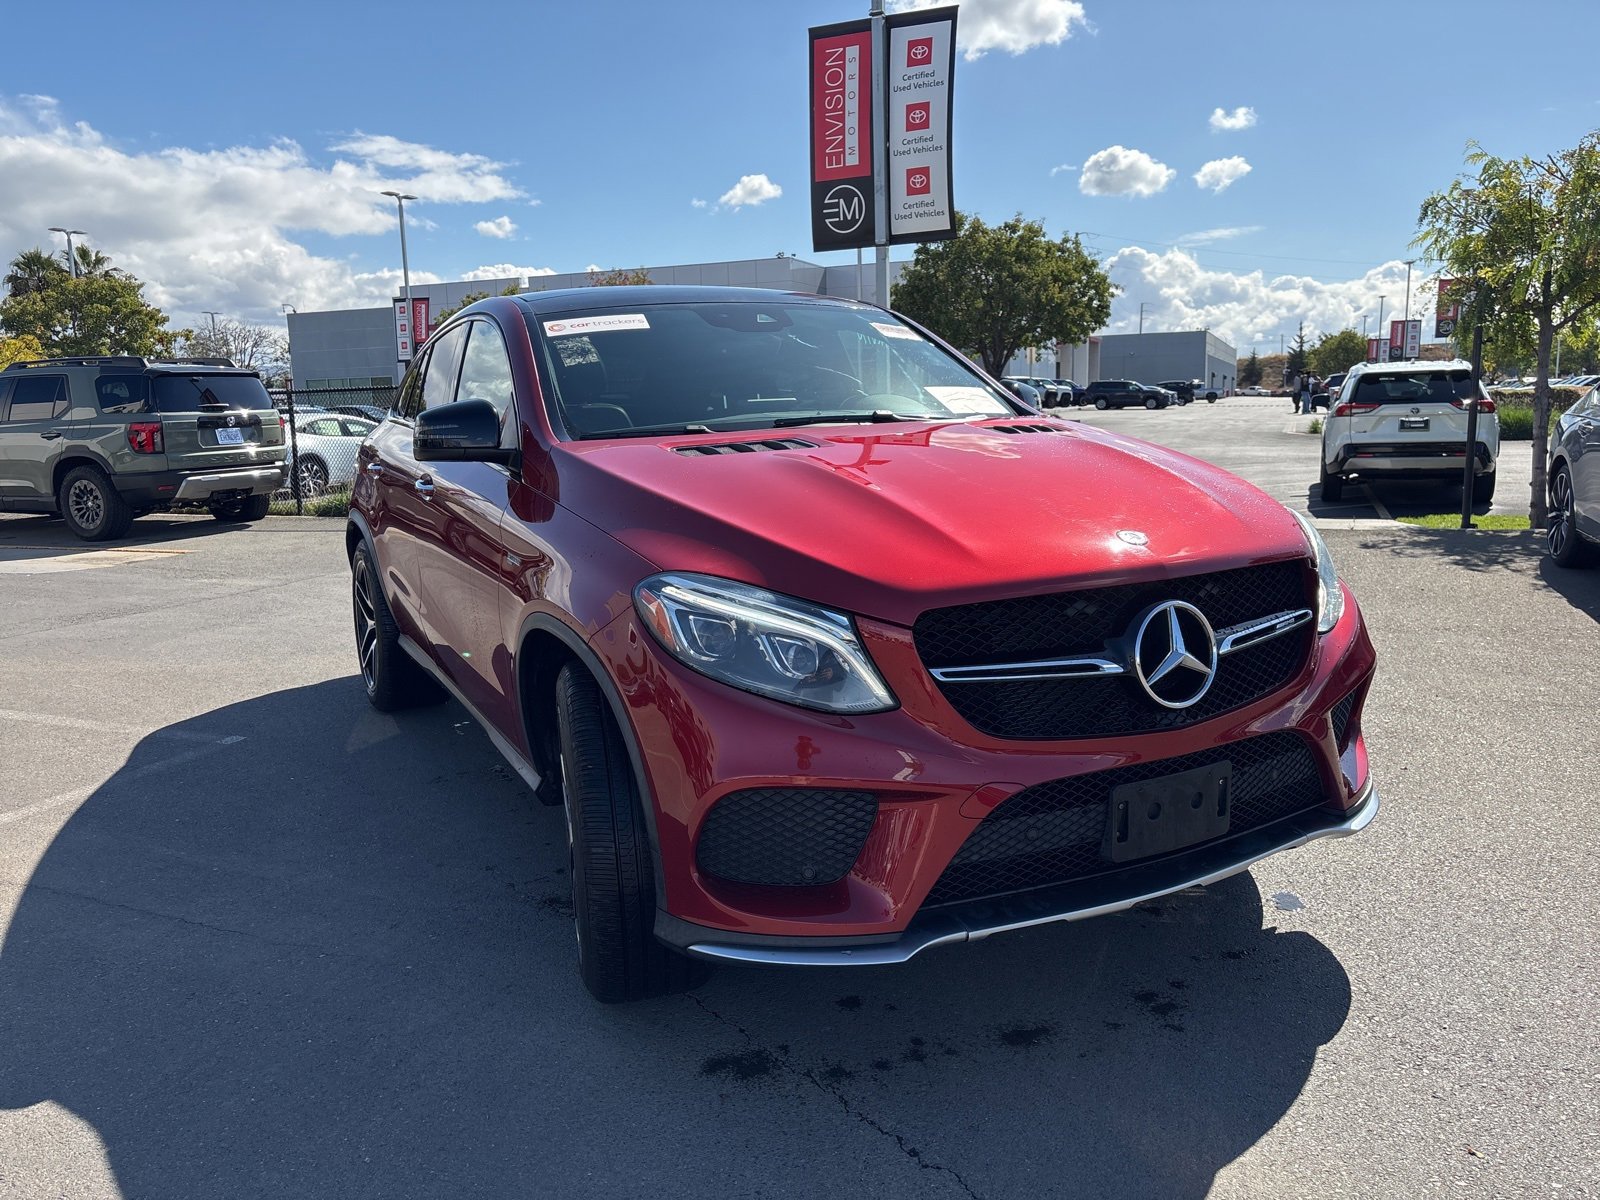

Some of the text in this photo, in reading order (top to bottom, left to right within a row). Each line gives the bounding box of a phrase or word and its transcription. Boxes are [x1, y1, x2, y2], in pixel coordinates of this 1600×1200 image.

[902, 69, 935, 81] Certified
[893, 79, 945, 92] Used Vehicles
[825, 47, 844, 169] ENVISION
[848, 56, 857, 156] MOTORS
[901, 134, 934, 146] Certified
[893, 144, 944, 157] Used Vehicles
[902, 199, 935, 210] Certified
[894, 209, 945, 221] Used Vehicles
